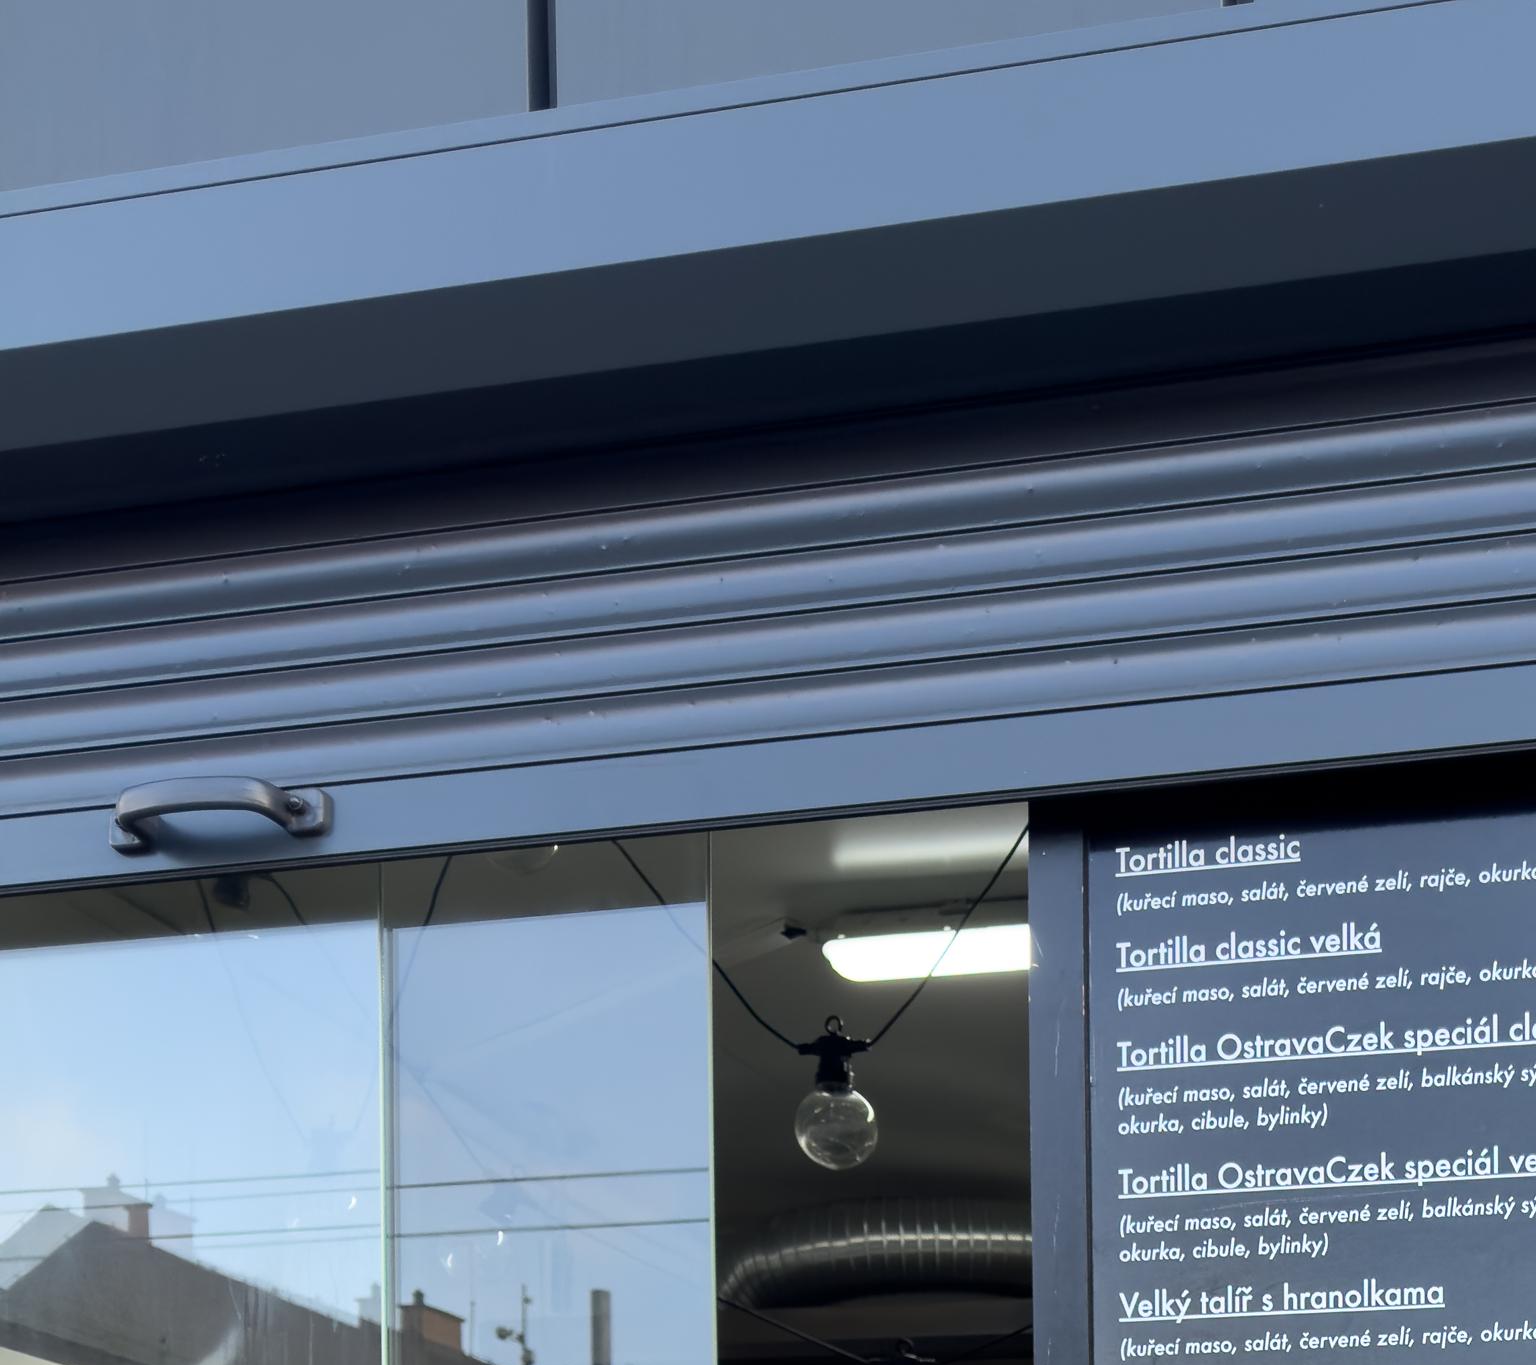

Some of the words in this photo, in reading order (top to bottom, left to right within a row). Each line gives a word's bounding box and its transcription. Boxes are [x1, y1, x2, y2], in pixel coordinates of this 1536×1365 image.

[1116, 840, 1204, 873] Tortilla
[1216, 834, 1300, 867] classic
[1117, 890, 1177, 917] (kuřecí
[1182, 891, 1233, 907] maso,
[1241, 881, 1288, 902] salát,
[1297, 875, 1368, 898] červené
[1375, 871, 1411, 892] zelí,
[1420, 868, 1470, 892] rajče,
[1116, 935, 1205, 969] Tortilla
[1216, 929, 1300, 962] classic
[1310, 922, 1380, 955] velká
[1118, 986, 1177, 1012] (kuřecí
[1183, 987, 1234, 1003] maso,
[1242, 977, 1289, 999] salát,
[1297, 972, 1369, 994] červené
[1375, 968, 1412, 990] zelí,
[1421, 966, 1471, 991] rajče,
[1117, 1035, 1206, 1069] Tortilla
[1217, 1023, 1393, 1063] OstravaCzek
[1405, 1016, 1497, 1055] speciál
[1119, 1085, 1178, 1110] (kuřecí
[1184, 1088, 1234, 1103] maso,
[1243, 1077, 1290, 1099] salát,
[1298, 1074, 1369, 1095] červené
[1376, 1069, 1413, 1091] zelí,
[1421, 1063, 1515, 1088] balkánský
[1118, 1112, 1183, 1135] okurka,
[1192, 1108, 1249, 1130] cibule,
[1257, 1103, 1327, 1132] bylinky)
[1118, 1163, 1207, 1197] Tortilla
[1218, 1154, 1394, 1192] OstravaCzek
[1406, 1148, 1498, 1186] speciál
[1120, 1214, 1179, 1238] (kuřecí
[1185, 1216, 1236, 1232] maso,
[1244, 1207, 1291, 1228] salát,
[1299, 1204, 1370, 1225] červené
[1377, 1200, 1413, 1222] zelí,
[1422, 1196, 1515, 1220] balkánský
[1120, 1240, 1185, 1263] okurka,
[1193, 1237, 1250, 1259] cibule,
[1258, 1233, 1328, 1260] bylinky)
[1119, 1289, 1191, 1321] Velký
[1201, 1286, 1252, 1318] talíř
[1263, 1293, 1273, 1316] s
[1284, 1281, 1443, 1315] hranolkama
[1121, 1338, 1180, 1361] (kuřecí
[1186, 1340, 1236, 1355] maso,
[1245, 1331, 1291, 1353] salát,
[1300, 1329, 1370, 1350] červené
[1377, 1326, 1414, 1348] zelí,
[1423, 1325, 1472, 1349] rajče,
